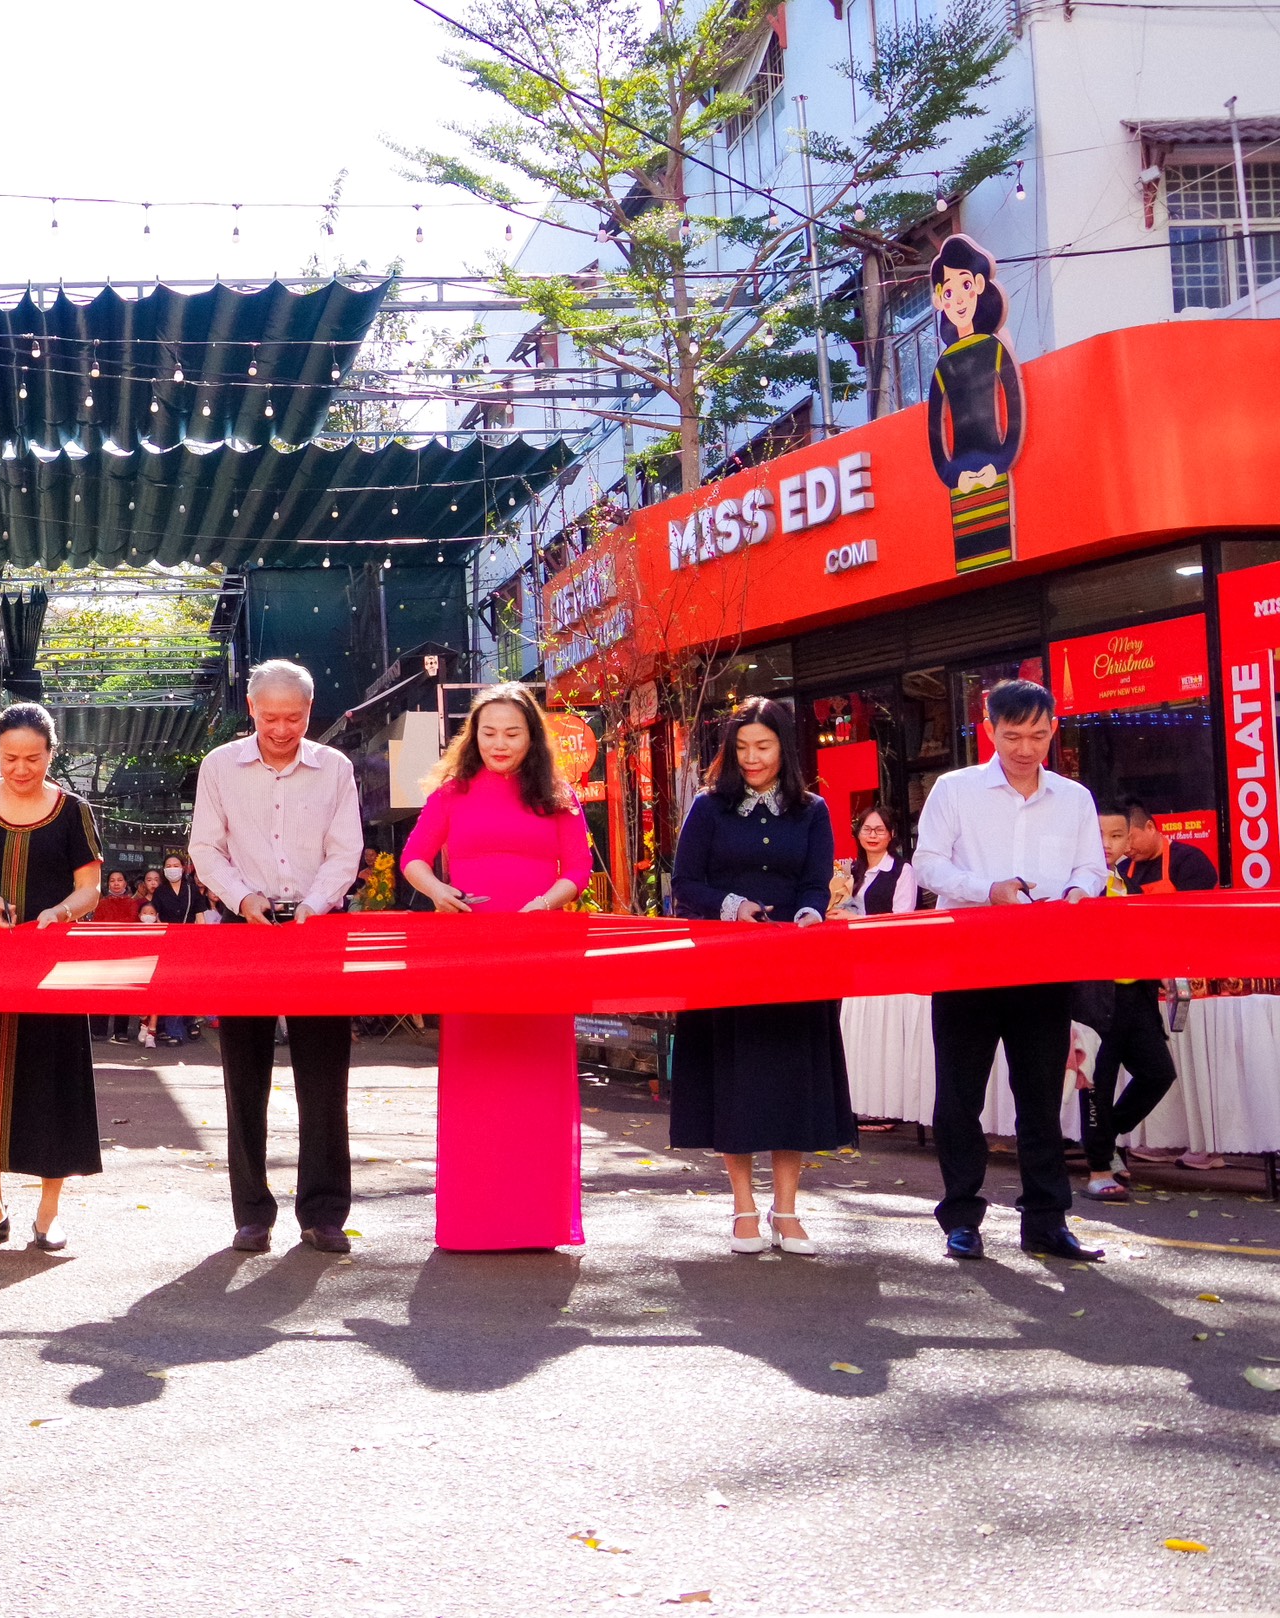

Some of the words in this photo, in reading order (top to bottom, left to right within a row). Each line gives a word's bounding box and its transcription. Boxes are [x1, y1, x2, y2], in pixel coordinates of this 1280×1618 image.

[668, 488, 775, 572] MISS
[779, 452, 875, 535] EDE
[1107, 635, 1144, 655] Merry
[1093, 653, 1156, 680] Christmas
[1120, 675, 1131, 684] and
[1099, 689, 1117, 699] HAPPY
[1117, 687, 1131, 697] NEW
[1131, 685, 1146, 695] YEAR
[1231, 662, 1271, 890] OCOLATE
[1161, 821, 1183, 832] MISS
